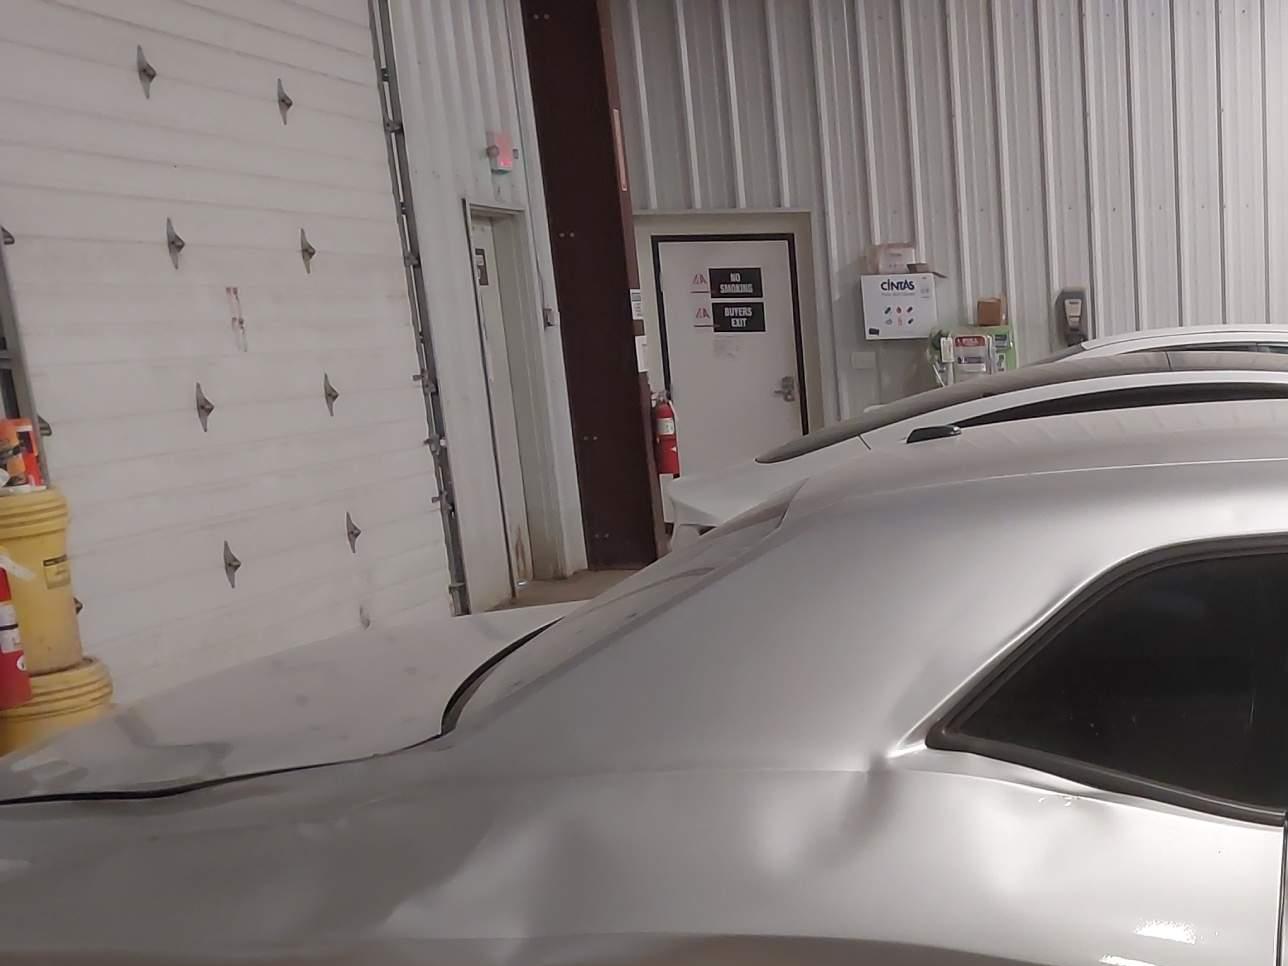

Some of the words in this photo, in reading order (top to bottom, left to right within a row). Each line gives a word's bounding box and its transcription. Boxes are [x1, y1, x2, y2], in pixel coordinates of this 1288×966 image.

[730, 273, 741, 282] NO
[720, 283, 753, 293] SMOKING
[880, 279, 915, 291] CINTAS
[724, 307, 752, 317] BUYERS
[731, 318, 747, 328] EXIT
